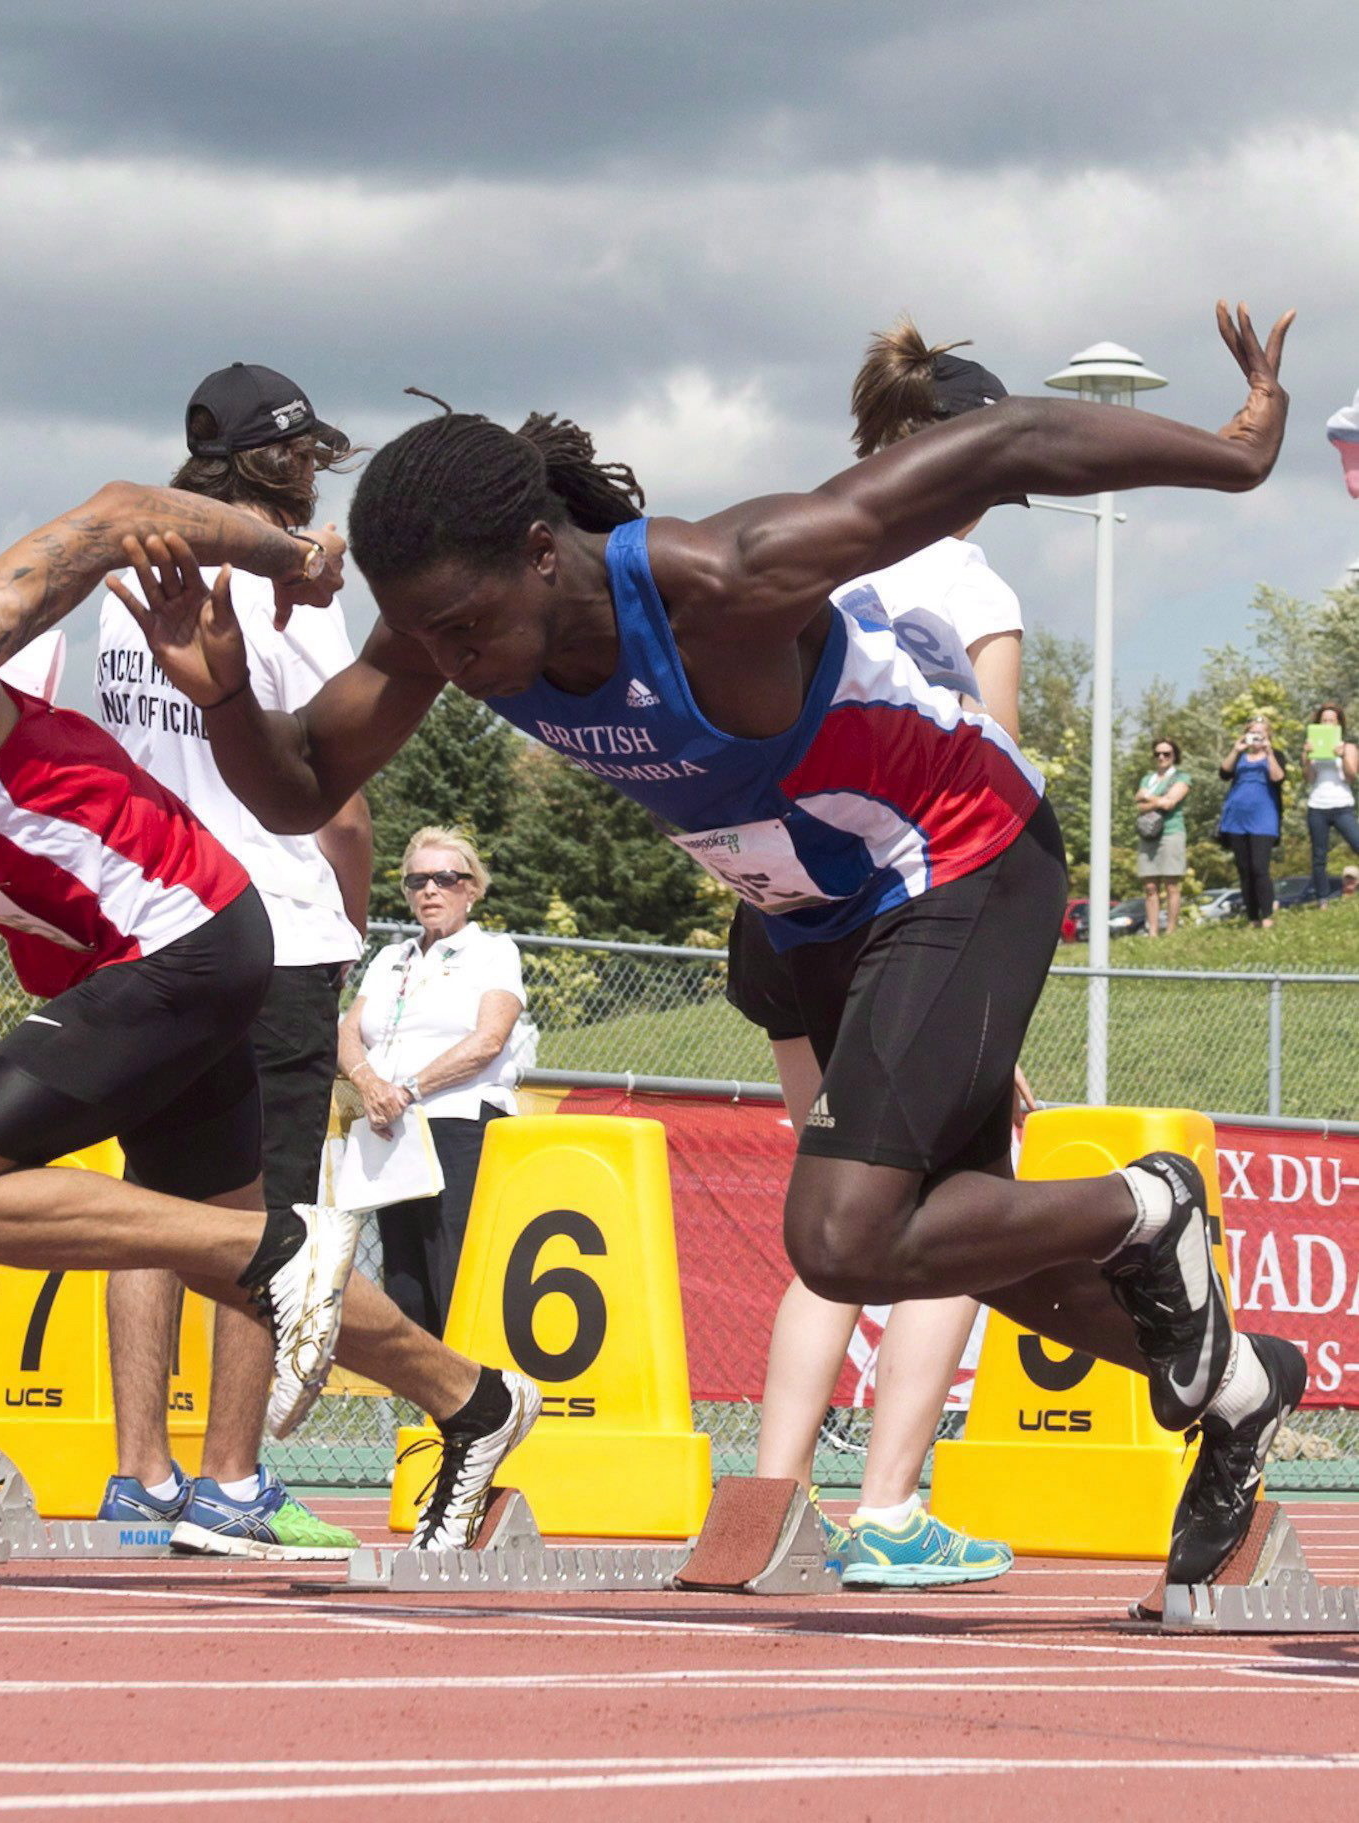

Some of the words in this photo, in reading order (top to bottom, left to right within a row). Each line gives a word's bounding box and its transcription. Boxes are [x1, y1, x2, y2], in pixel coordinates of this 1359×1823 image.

[101, 692, 131, 725] NOT
[138, 694, 209, 740] OFICIAL
[536, 720, 659, 755] BRITISH
[1215, 1148, 1259, 1201] X
[502, 1209, 607, 1383] 6
[5, 1388, 63, 1408] UCS
[538, 1396, 596, 1417] CS
[1018, 1409, 1092, 1432] UCS
